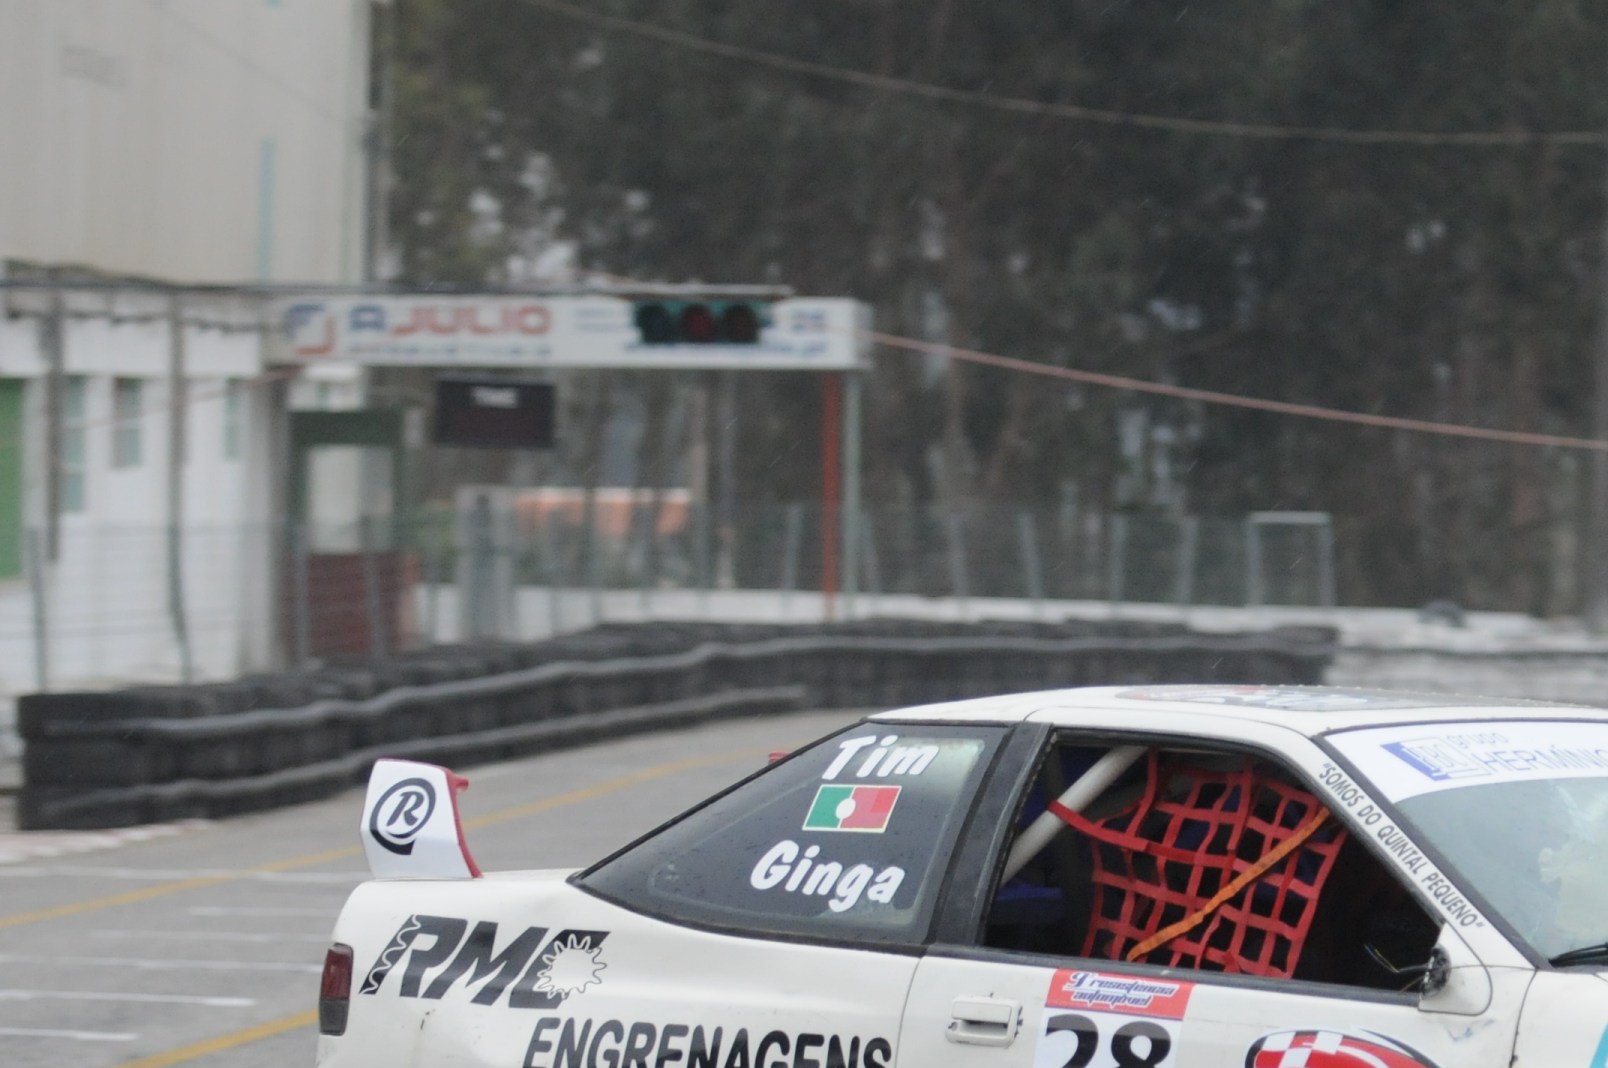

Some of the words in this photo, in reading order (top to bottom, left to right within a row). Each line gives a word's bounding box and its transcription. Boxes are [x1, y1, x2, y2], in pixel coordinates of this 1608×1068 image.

[822, 735, 940, 780] Tim
[1357, 802, 1383, 826] DO
[1377, 825, 1427, 875] QUINTAL
[750, 840, 905, 912] Ginga
